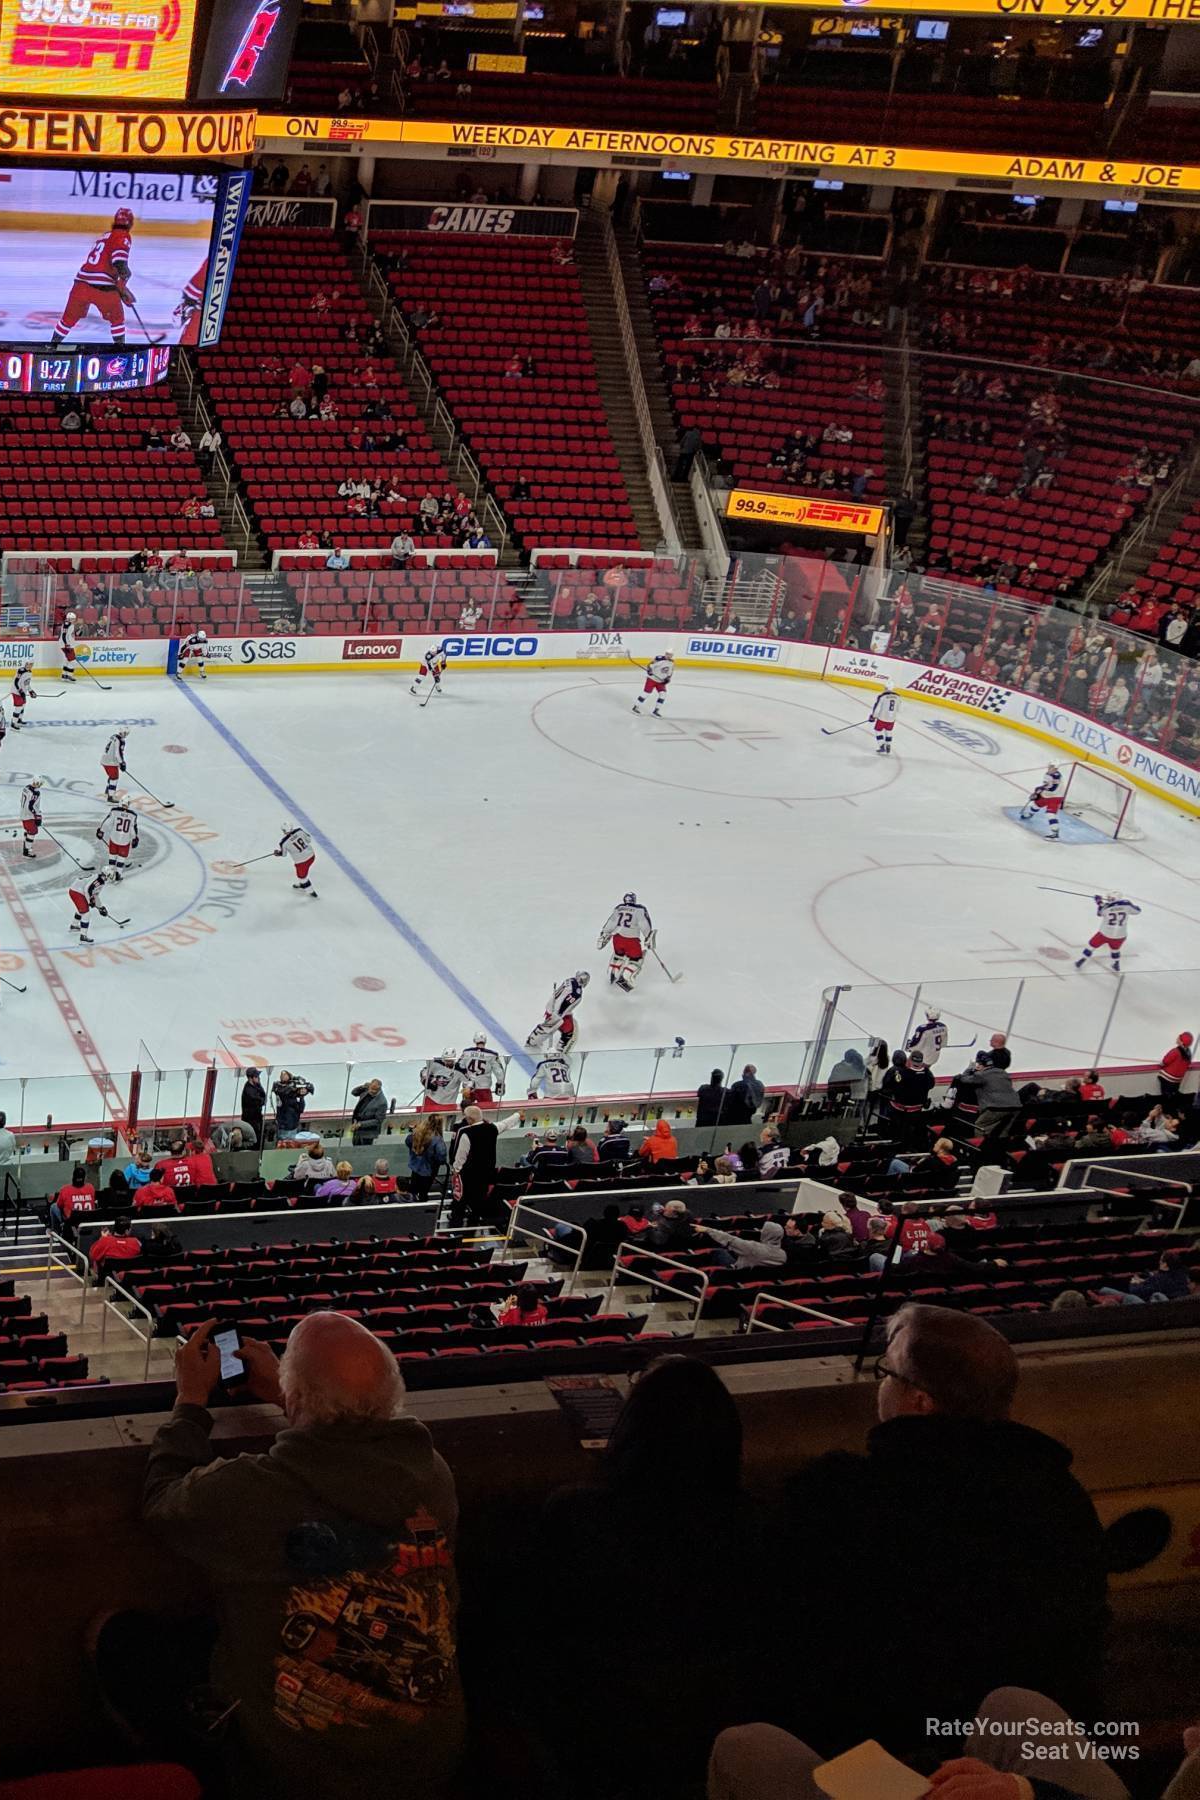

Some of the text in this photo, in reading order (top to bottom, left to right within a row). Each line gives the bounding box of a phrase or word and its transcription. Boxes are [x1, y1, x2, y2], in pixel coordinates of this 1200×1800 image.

[91, 12, 158, 28] THE FAN
[11, 24, 156, 70] ESPN
[116, 115, 167, 153] TO
[177, 114, 243, 153] YOUR
[286, 119, 348, 136] ON 99.9
[452, 125, 897, 167] WEEKDAY AFTERNOONS STARTING AT 3
[1006, 158, 1183, 187] ADAM & JOE
[70, 171, 184, 201] Michael
[245, 201, 303, 227] ARNING
[428, 207, 516, 234] CANES
[204, 181, 244, 340] WRAL NEWS
[8, 356, 22, 379] 0
[40, 360, 71, 380] 9:27
[87, 357, 100, 380] 0
[138, 358, 144, 373] 0
[44, 383, 66, 392] FIRST
[94, 379, 138, 391] BLUE JACKETS
[736, 499, 766, 513] 99.9
[805, 502, 871, 525] ESPN
[442, 637, 538, 656] GEICO
[589, 633, 623, 646] DNA
[92, 651, 136, 665] Lottery
[258, 642, 296, 660] sas
[347, 643, 397, 656] Lenovo
[690, 641, 778, 658] BUD LIGHT
[919, 669, 986, 697] Advance
[906, 679, 981, 708] Auto Parts
[26, 718, 157, 728] ticketmas
[1022, 700, 1112, 755] UNC REX
[116, 817, 131, 833] 20
[1108, 912, 1126, 926] 27
[934, 1034, 942, 1051] 9
[467, 1058, 487, 1075] 45
[550, 1067, 570, 1083] 28
